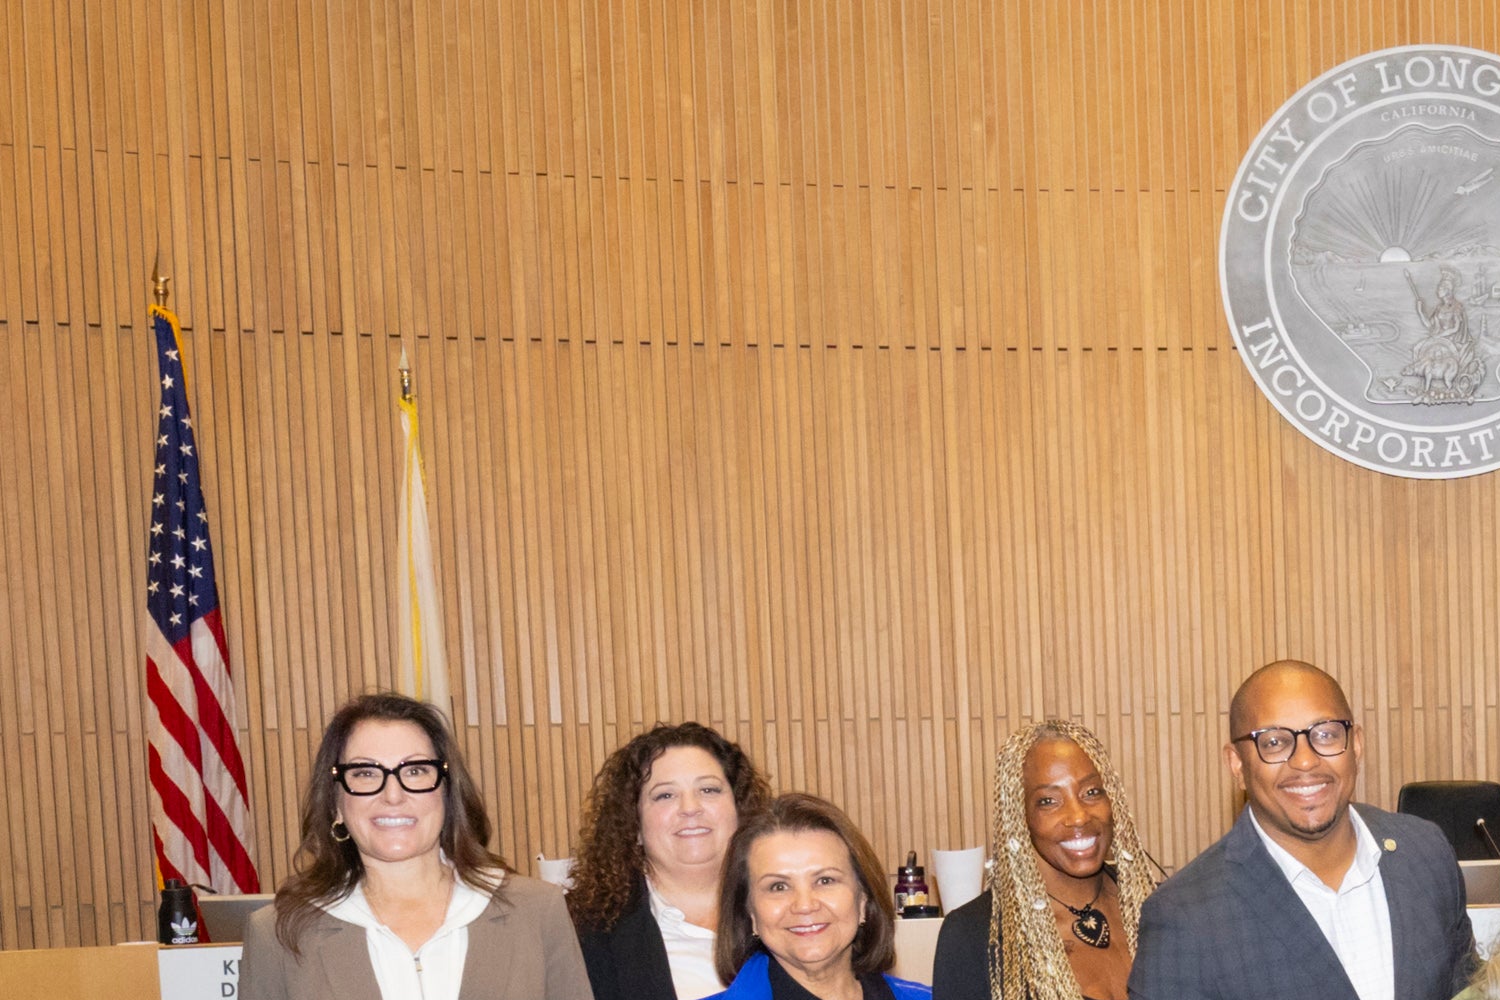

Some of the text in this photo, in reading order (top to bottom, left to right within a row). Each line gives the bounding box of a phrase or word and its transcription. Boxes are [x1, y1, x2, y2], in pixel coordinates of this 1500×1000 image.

[1380, 104, 1476, 122] CALIFORNIA
[1238, 119, 1305, 223] CITY
[1307, 72, 1359, 125] OF
[172, 936, 198, 944] adidas
